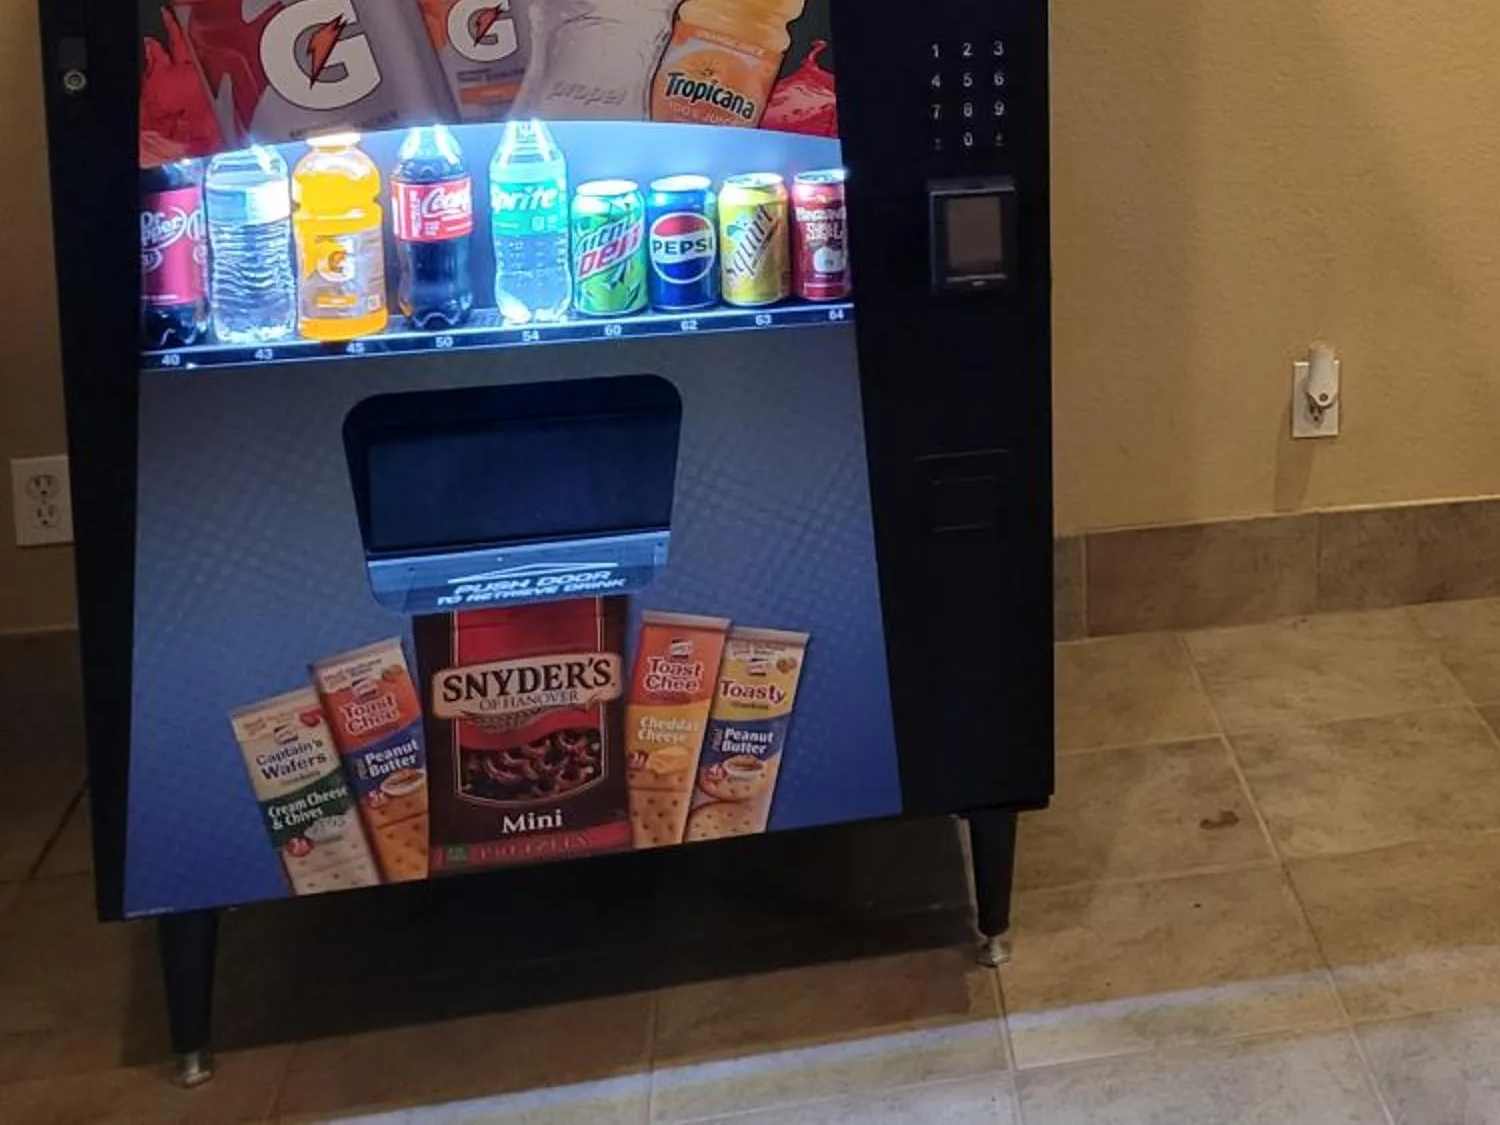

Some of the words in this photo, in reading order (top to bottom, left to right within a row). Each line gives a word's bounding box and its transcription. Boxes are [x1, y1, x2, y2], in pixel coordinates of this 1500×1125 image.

[665, 72, 755, 119] Tropicana
[653, 237, 713, 255] PEPSI
[435, 336, 453, 348] 50
[522, 330, 540, 342] 54
[604, 325, 622, 336] 60
[254, 348, 273, 360] 43
[453, 578, 531, 595] PUSH
[536, 570, 612, 587] DOOR
[647, 656, 704, 678] Toast
[442, 657, 612, 703] SNYDER'S
[643, 675, 701, 693] Chee
[719, 679, 787, 705] Toasty
[341, 693, 398, 719] Toast
[479, 698, 499, 711] OF
[503, 689, 580, 708] HANOVER
[345, 710, 399, 735] Chee
[724, 727, 775, 743] Peanut
[255, 738, 325, 766] Captain's
[364, 737, 419, 764] Peanut
[721, 740, 768, 755] Butter
[260, 753, 328, 780] Wafers
[367, 753, 418, 778] Butter
[268, 800, 308, 818] Cream
[307, 786, 349, 806] Cheese
[501, 808, 563, 835] Mini
